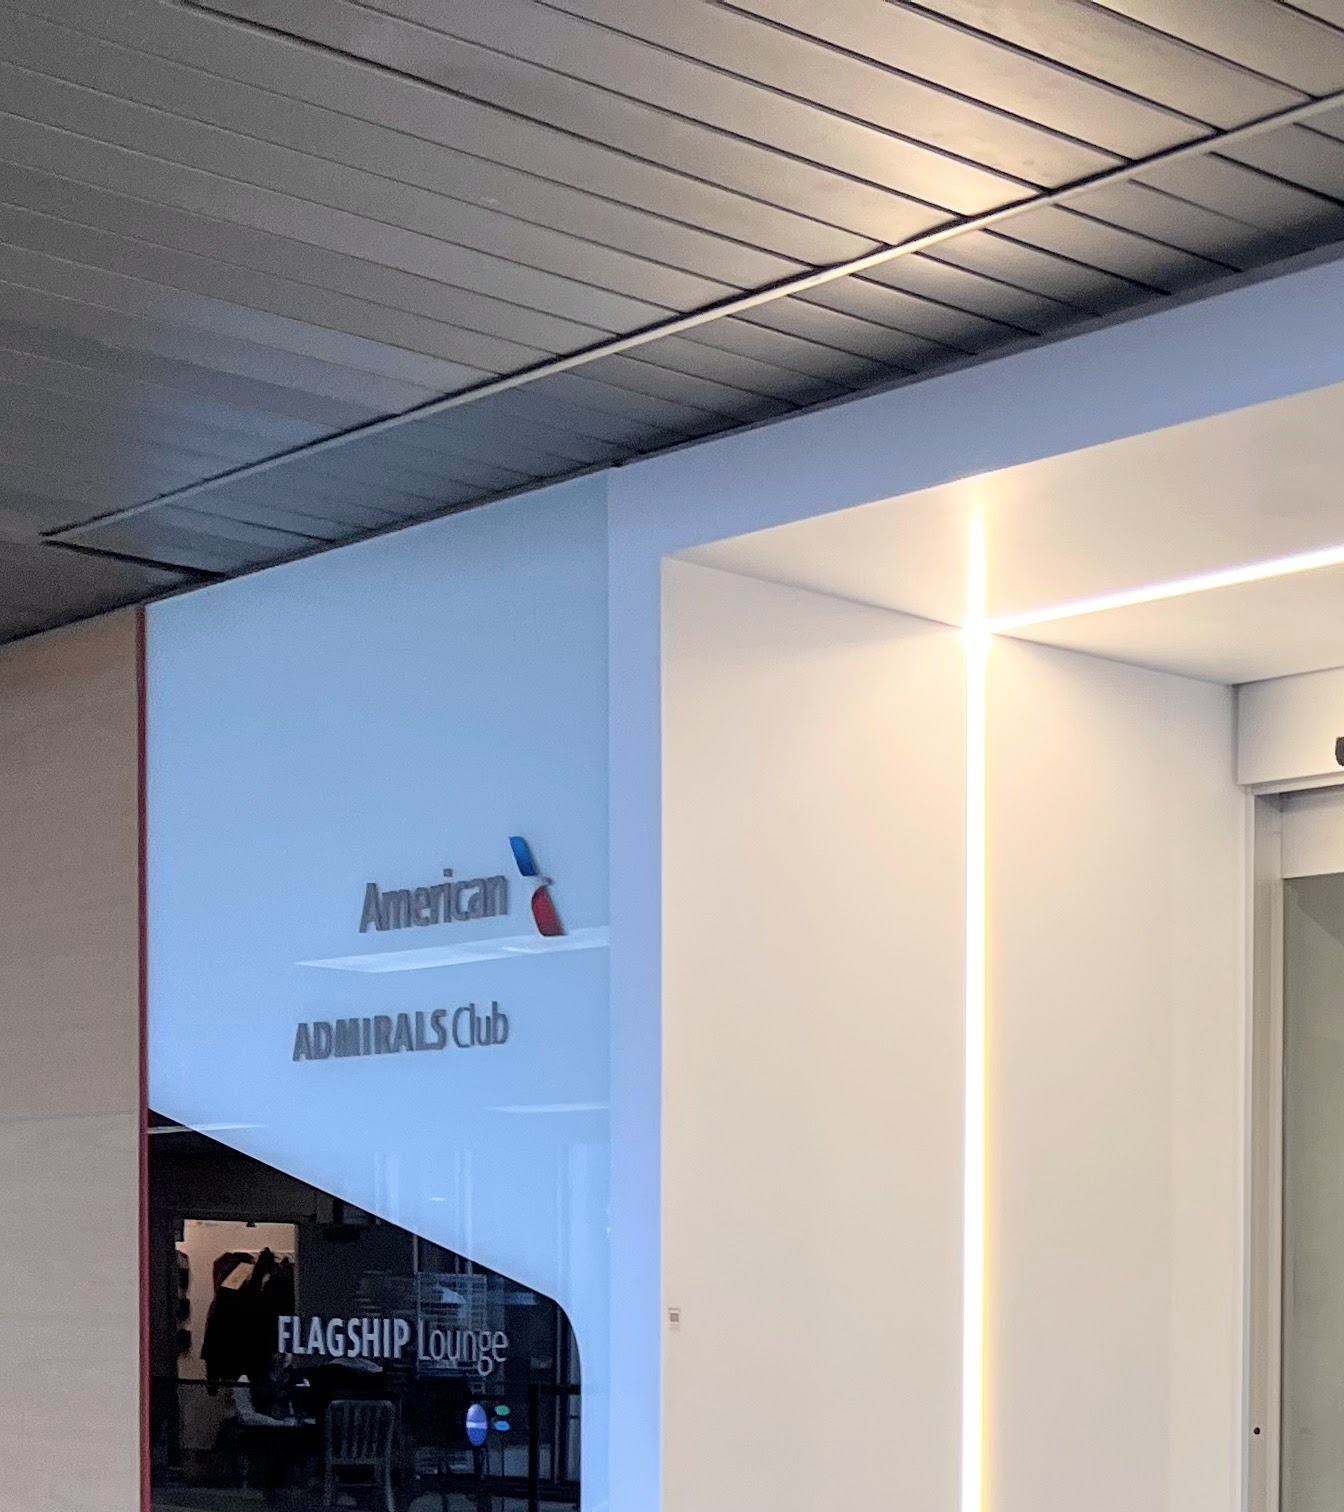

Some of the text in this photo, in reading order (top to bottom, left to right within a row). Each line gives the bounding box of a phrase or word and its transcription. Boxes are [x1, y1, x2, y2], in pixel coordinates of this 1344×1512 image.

[359, 868, 509, 933] American
[292, 1000, 510, 1062] ADMIRALS Club
[277, 1315, 509, 1377] FLAGSHIP Lounge
